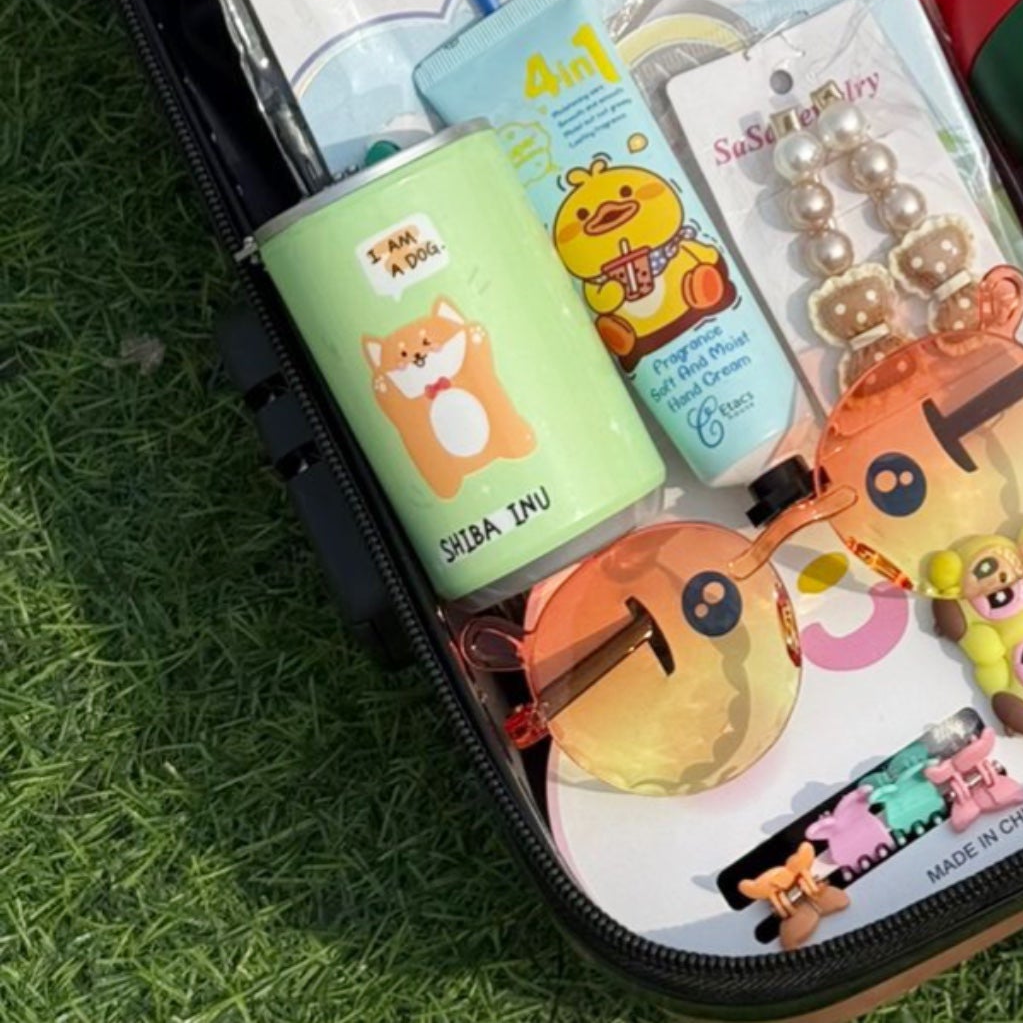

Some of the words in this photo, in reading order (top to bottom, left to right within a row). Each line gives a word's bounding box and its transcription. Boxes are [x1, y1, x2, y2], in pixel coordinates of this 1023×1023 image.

[523, 21, 622, 100] 4in1
[366, 248, 381, 265] I
[387, 230, 418, 254] AM
[391, 262, 406, 279] A
[404, 240, 446, 270] DOG.
[650, 376, 677, 403] Soft
[677, 355, 709, 381] And
[708, 330, 751, 360] Moist
[666, 381, 703, 414] Hand
[701, 355, 752, 387] Cream
[439, 517, 502, 564] SHIBA
[506, 484, 551, 527] INU
[925, 841, 980, 884] MADE
[976, 828, 1000, 850] IN
